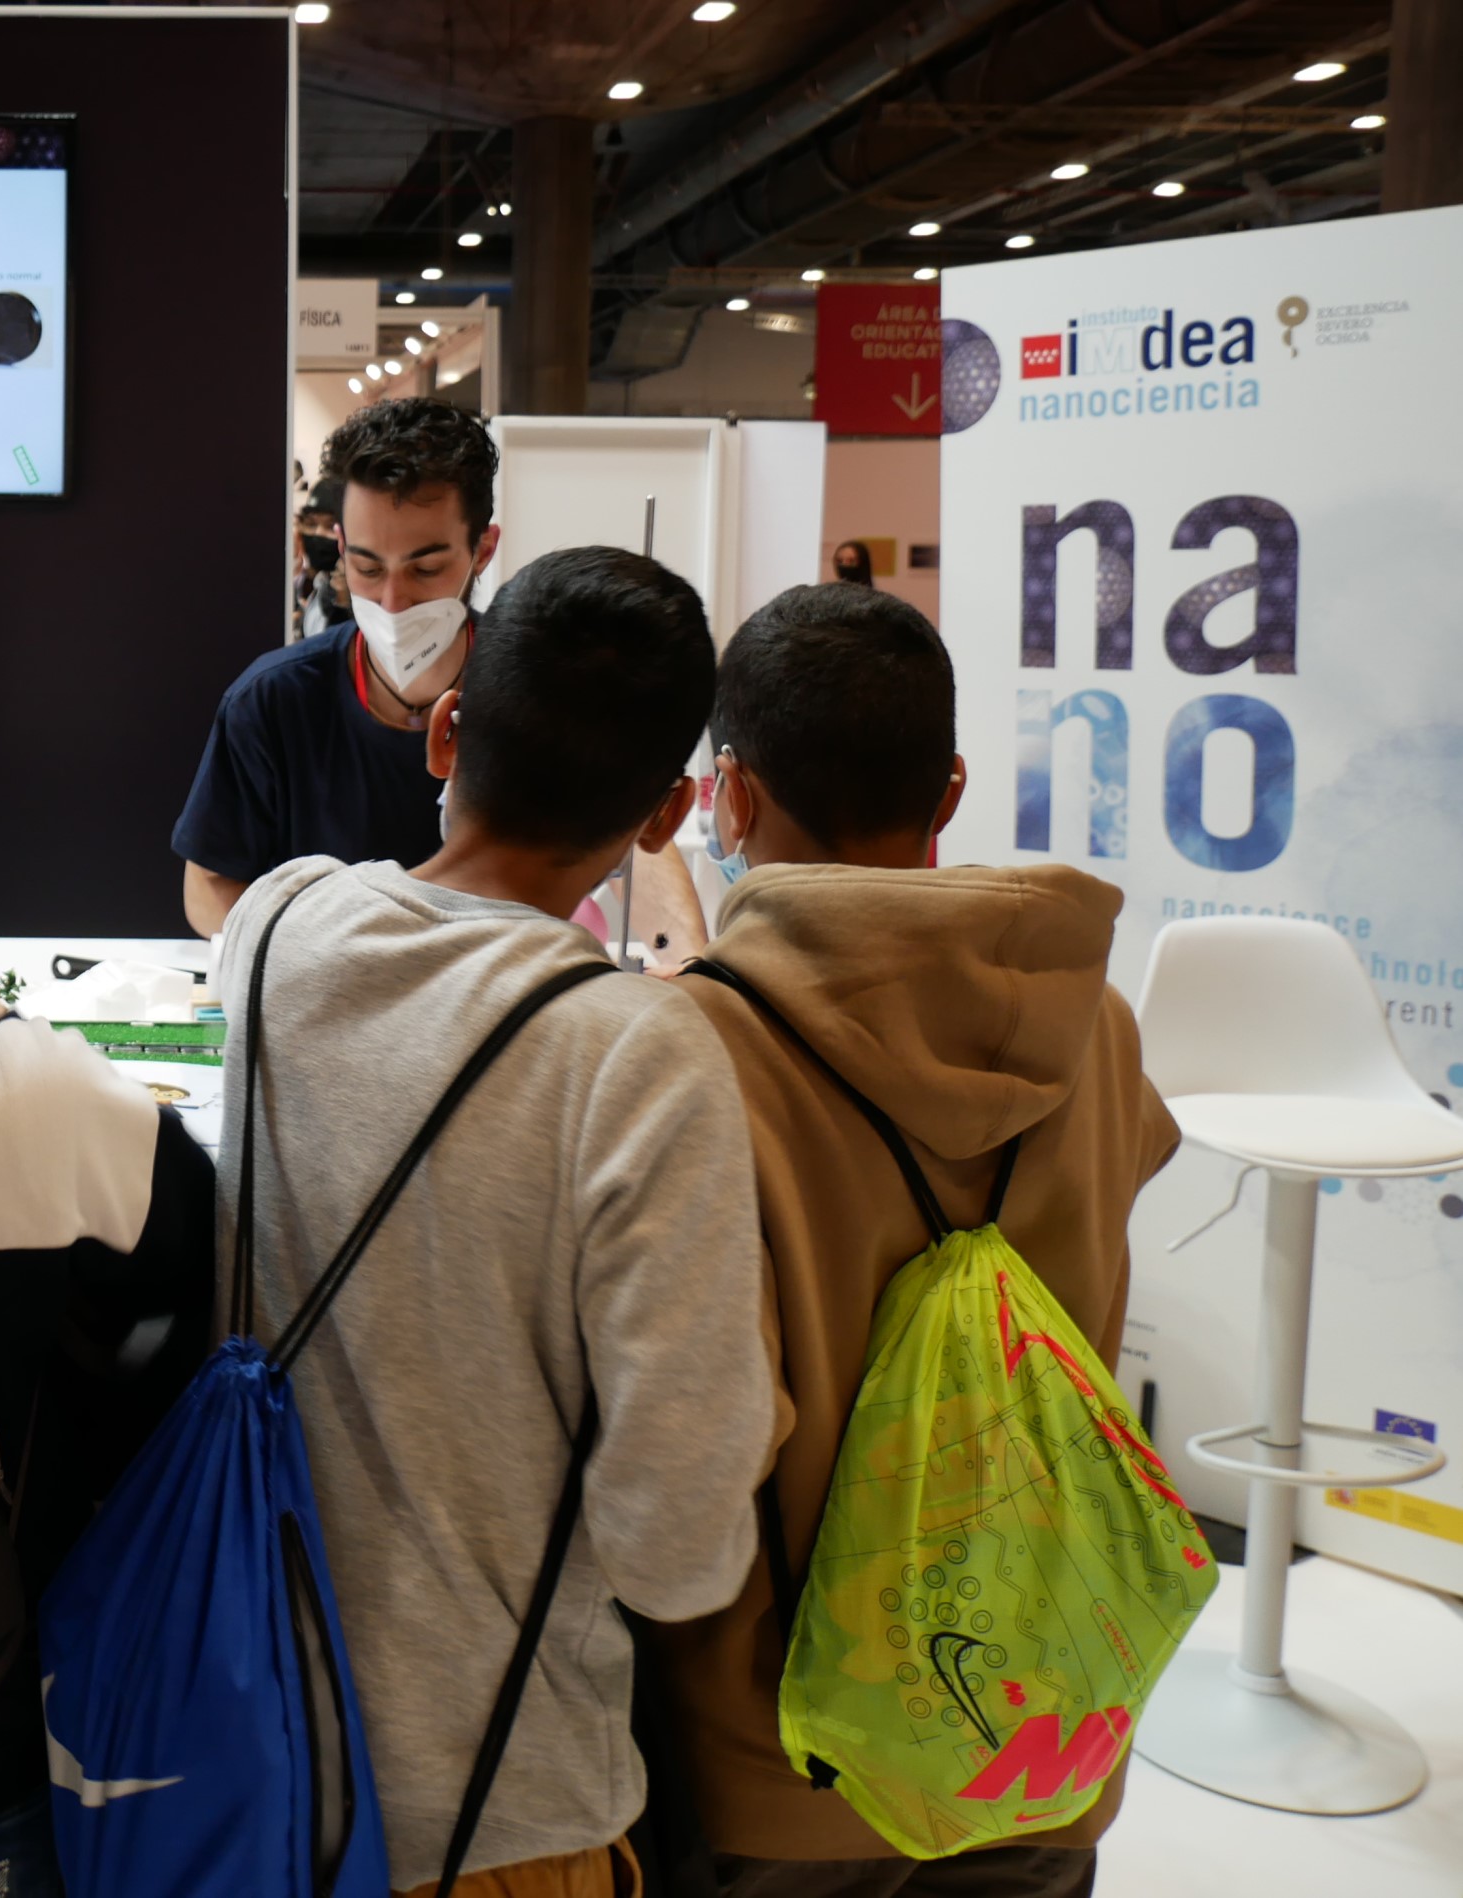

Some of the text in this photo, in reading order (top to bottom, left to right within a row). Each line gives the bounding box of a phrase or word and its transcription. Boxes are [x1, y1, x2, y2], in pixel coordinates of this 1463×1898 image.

[299, 307, 342, 327] FÍSICA
[1082, 306, 1158, 327] instituto
[1019, 371, 1260, 423] nanociencia
[1020, 494, 1300, 676] na
[1014, 688, 1296, 873] no
